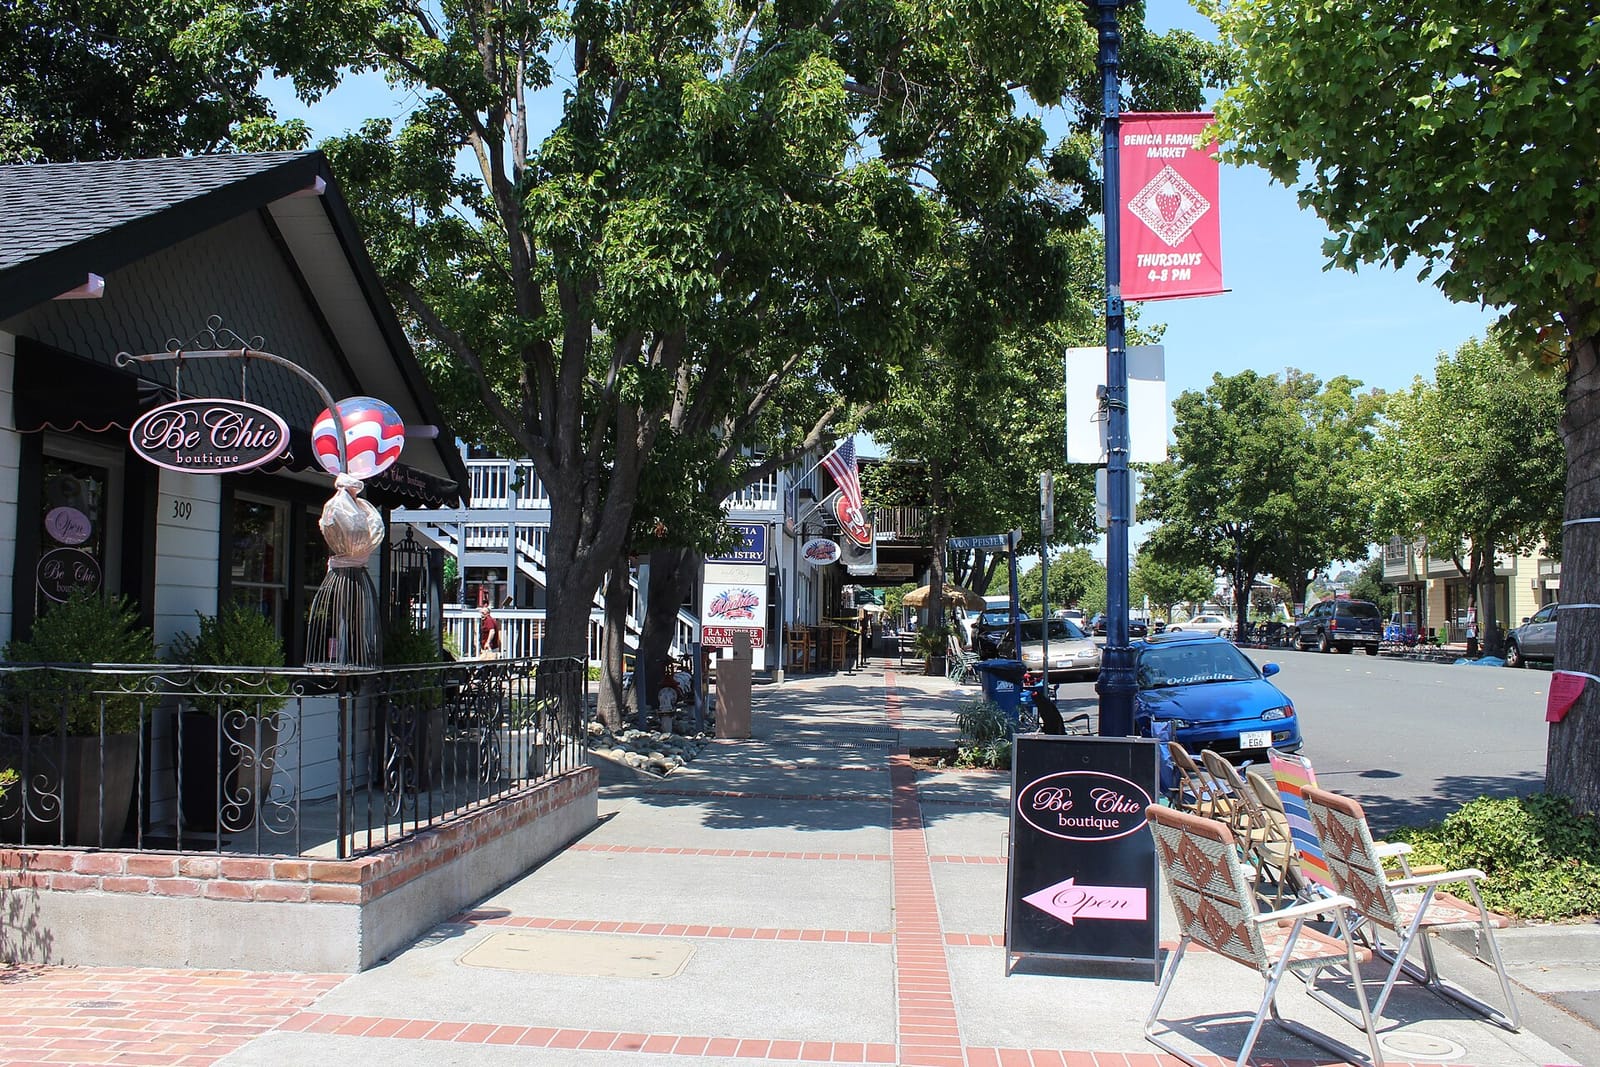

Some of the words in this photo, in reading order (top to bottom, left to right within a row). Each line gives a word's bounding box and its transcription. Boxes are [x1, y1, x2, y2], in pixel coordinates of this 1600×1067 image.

[1123, 134, 1162, 145] BENICIA
[1164, 133, 1201, 145] FARME
[1146, 146, 1187, 158] MARKET
[1136, 253, 1202, 267] THURSDAYS
[1147, 269, 1168, 282] 4-8
[1171, 269, 1191, 280] PM
[142, 410, 201, 449] Be
[203, 408, 278, 448] Chic
[175, 450, 239, 465] boutique
[172, 500, 192, 520] 309
[55, 512, 84, 538] Open
[953, 539, 970, 549] VON
[972, 536, 1006, 547] PFISTER
[43, 560, 64, 580] Be
[73, 561, 96, 582] Chic
[704, 636, 734, 645] INSURANC
[1167, 672, 1234, 685] Originality
[1248, 738, 1264, 747] EG6
[1032, 786, 1074, 811] Be
[1089, 787, 1141, 814] Chic
[1058, 813, 1120, 831] boutique
[1052, 888, 1130, 915] Open
